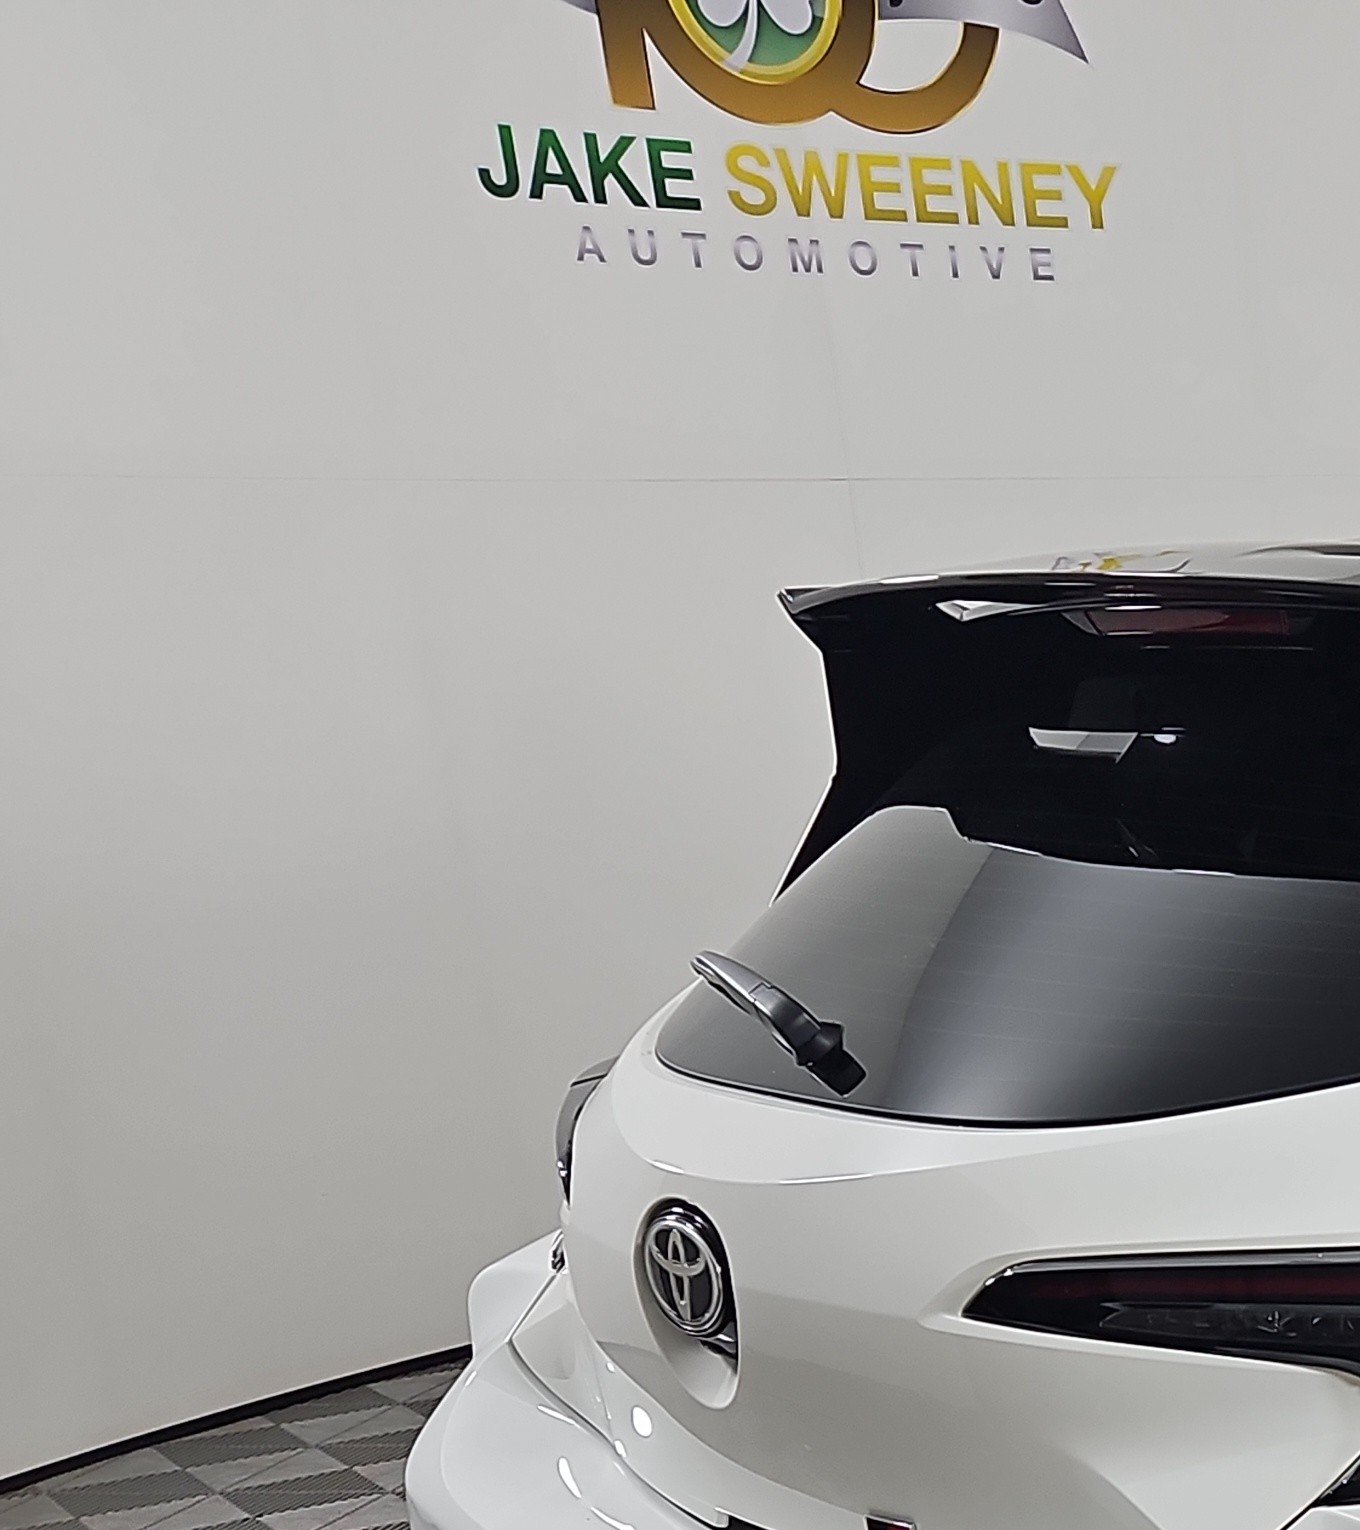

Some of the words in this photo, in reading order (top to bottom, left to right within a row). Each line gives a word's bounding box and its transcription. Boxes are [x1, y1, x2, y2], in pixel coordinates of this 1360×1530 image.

[476, 123, 702, 212] JAKE
[725, 143, 1118, 230] SWEENEY
[576, 225, 1056, 281] AUTOMOTIVE
